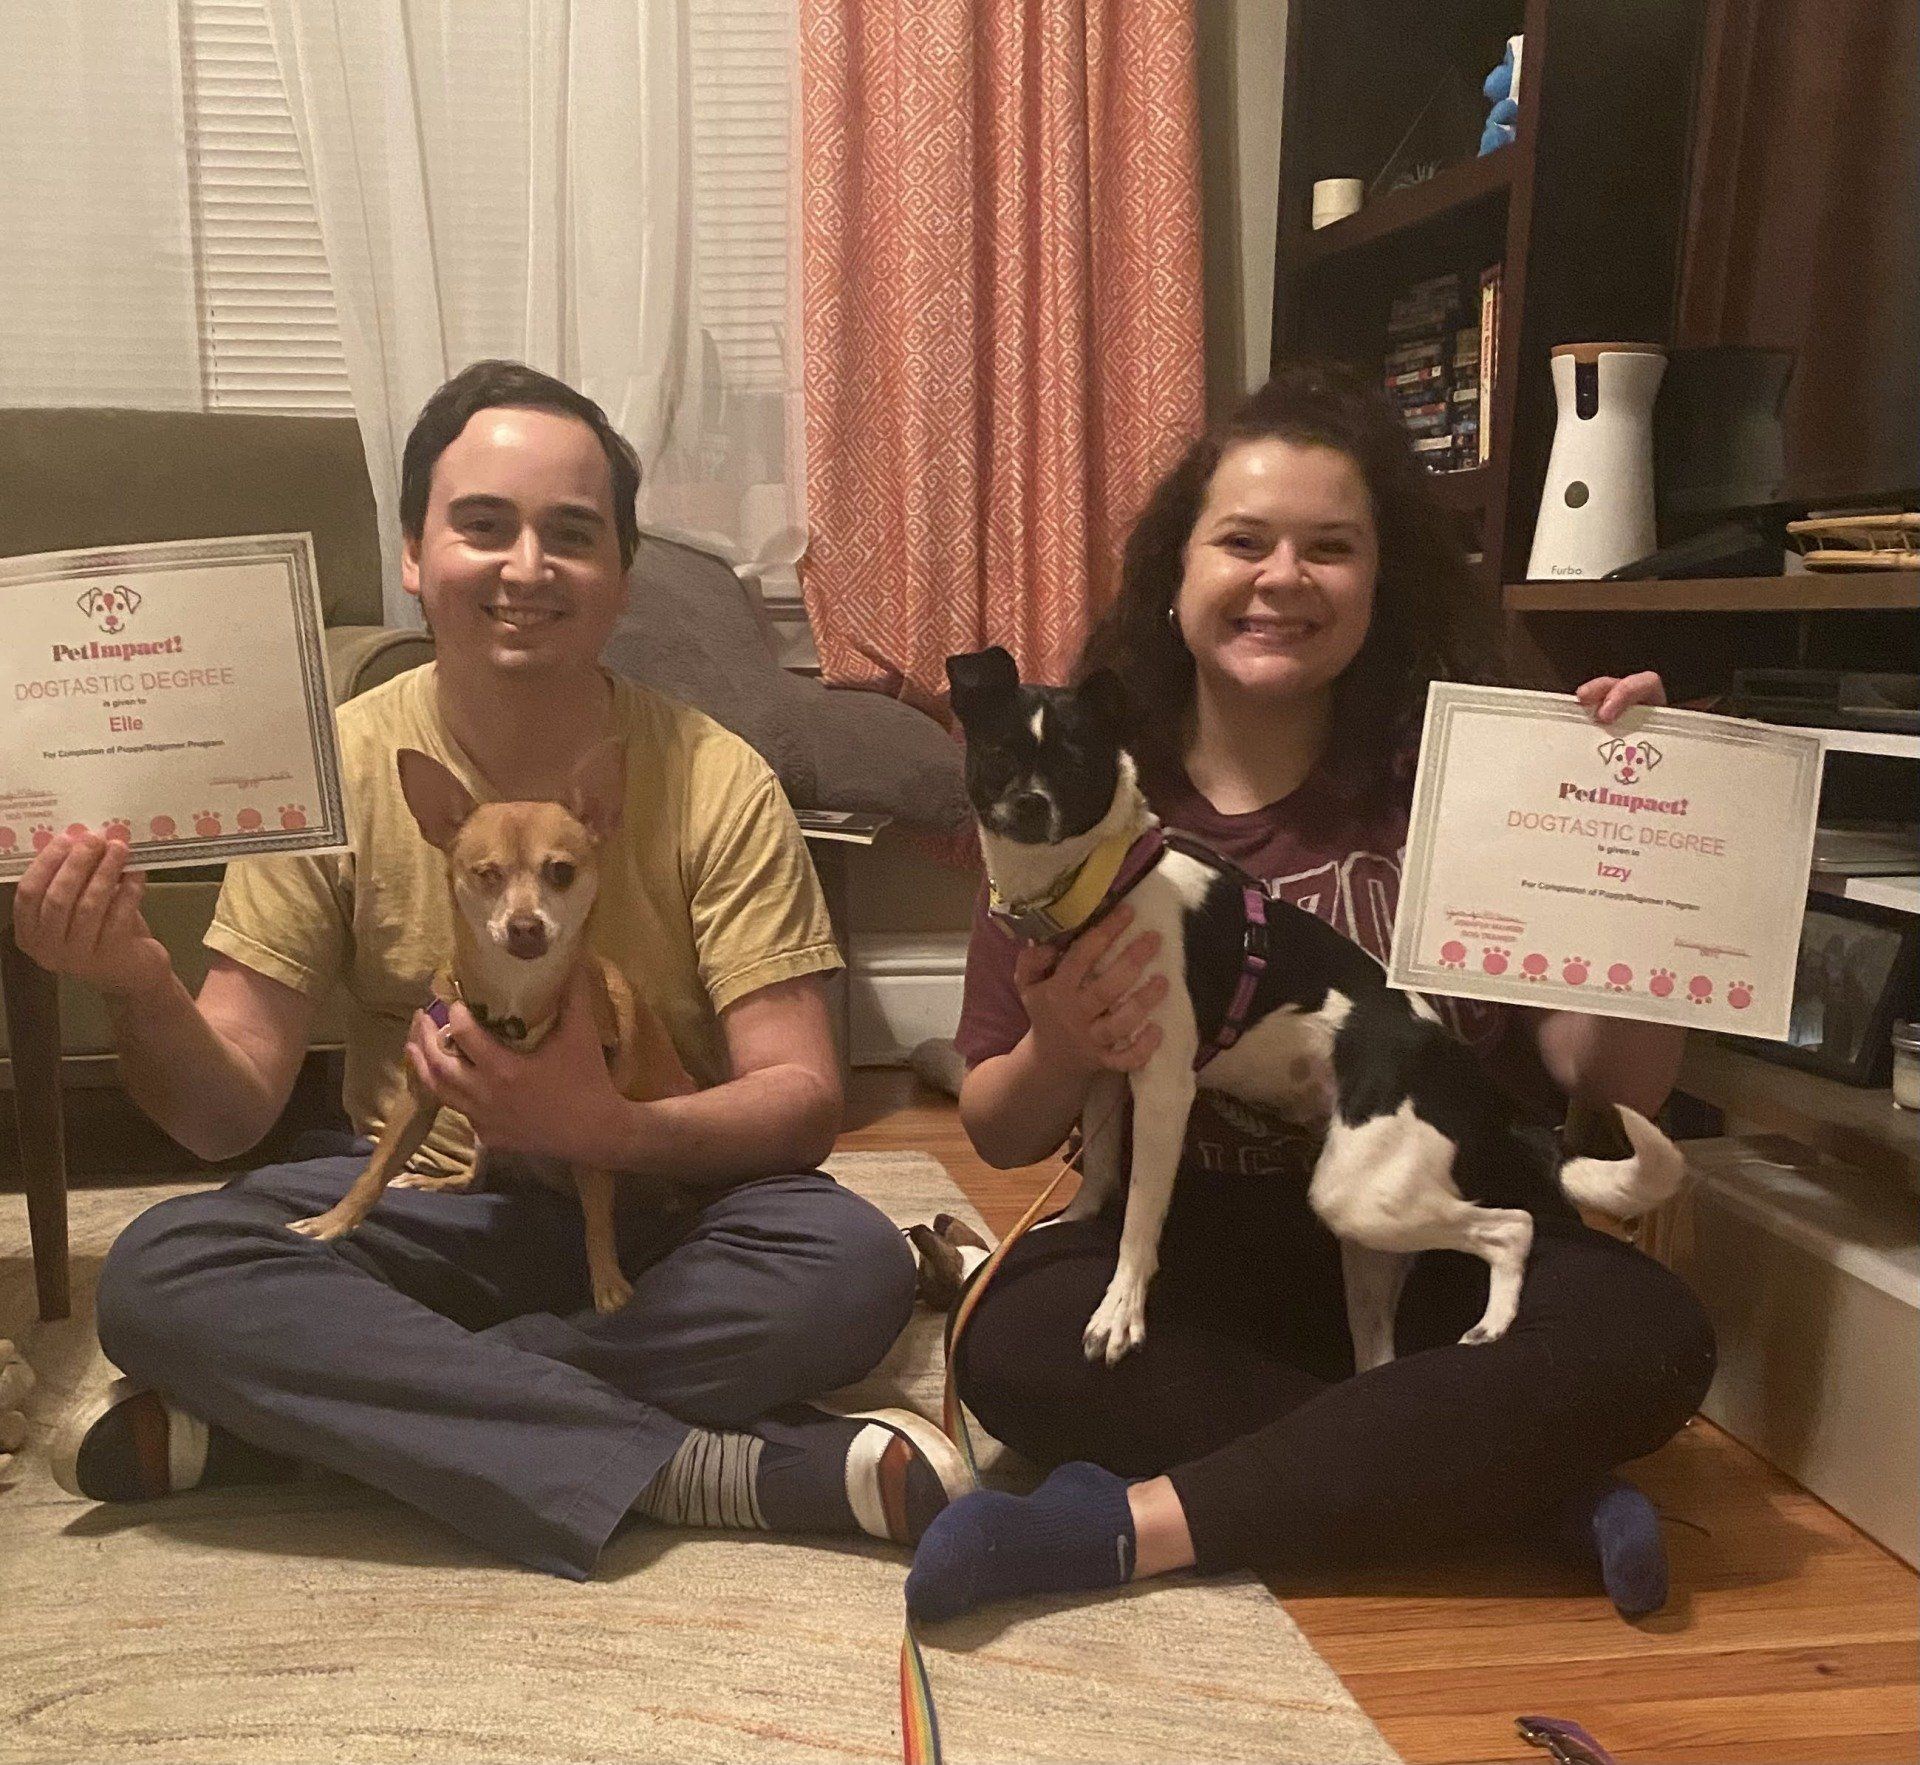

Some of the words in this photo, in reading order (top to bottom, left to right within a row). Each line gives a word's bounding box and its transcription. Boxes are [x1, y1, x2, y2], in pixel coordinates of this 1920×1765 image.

[52, 636, 182, 661] PetImpact!
[15, 674, 134, 701] DOGTASTIC
[141, 668, 235, 690] DEGREE
[113, 698, 135, 708] given
[109, 715, 143, 733] Elle
[43, 750, 56, 759] For
[58, 747, 104, 758] Completion
[106, 746, 115, 754] of
[187, 739, 225, 749] Program
[1559, 782, 1688, 815] PetImpact!
[1507, 810, 1634, 841] DOGTASTIC
[1639, 827, 1726, 856] DEGREE
[1607, 846, 1630, 856] given
[1597, 862, 1631, 883] Izzy
[1521, 879, 1536, 889] For
